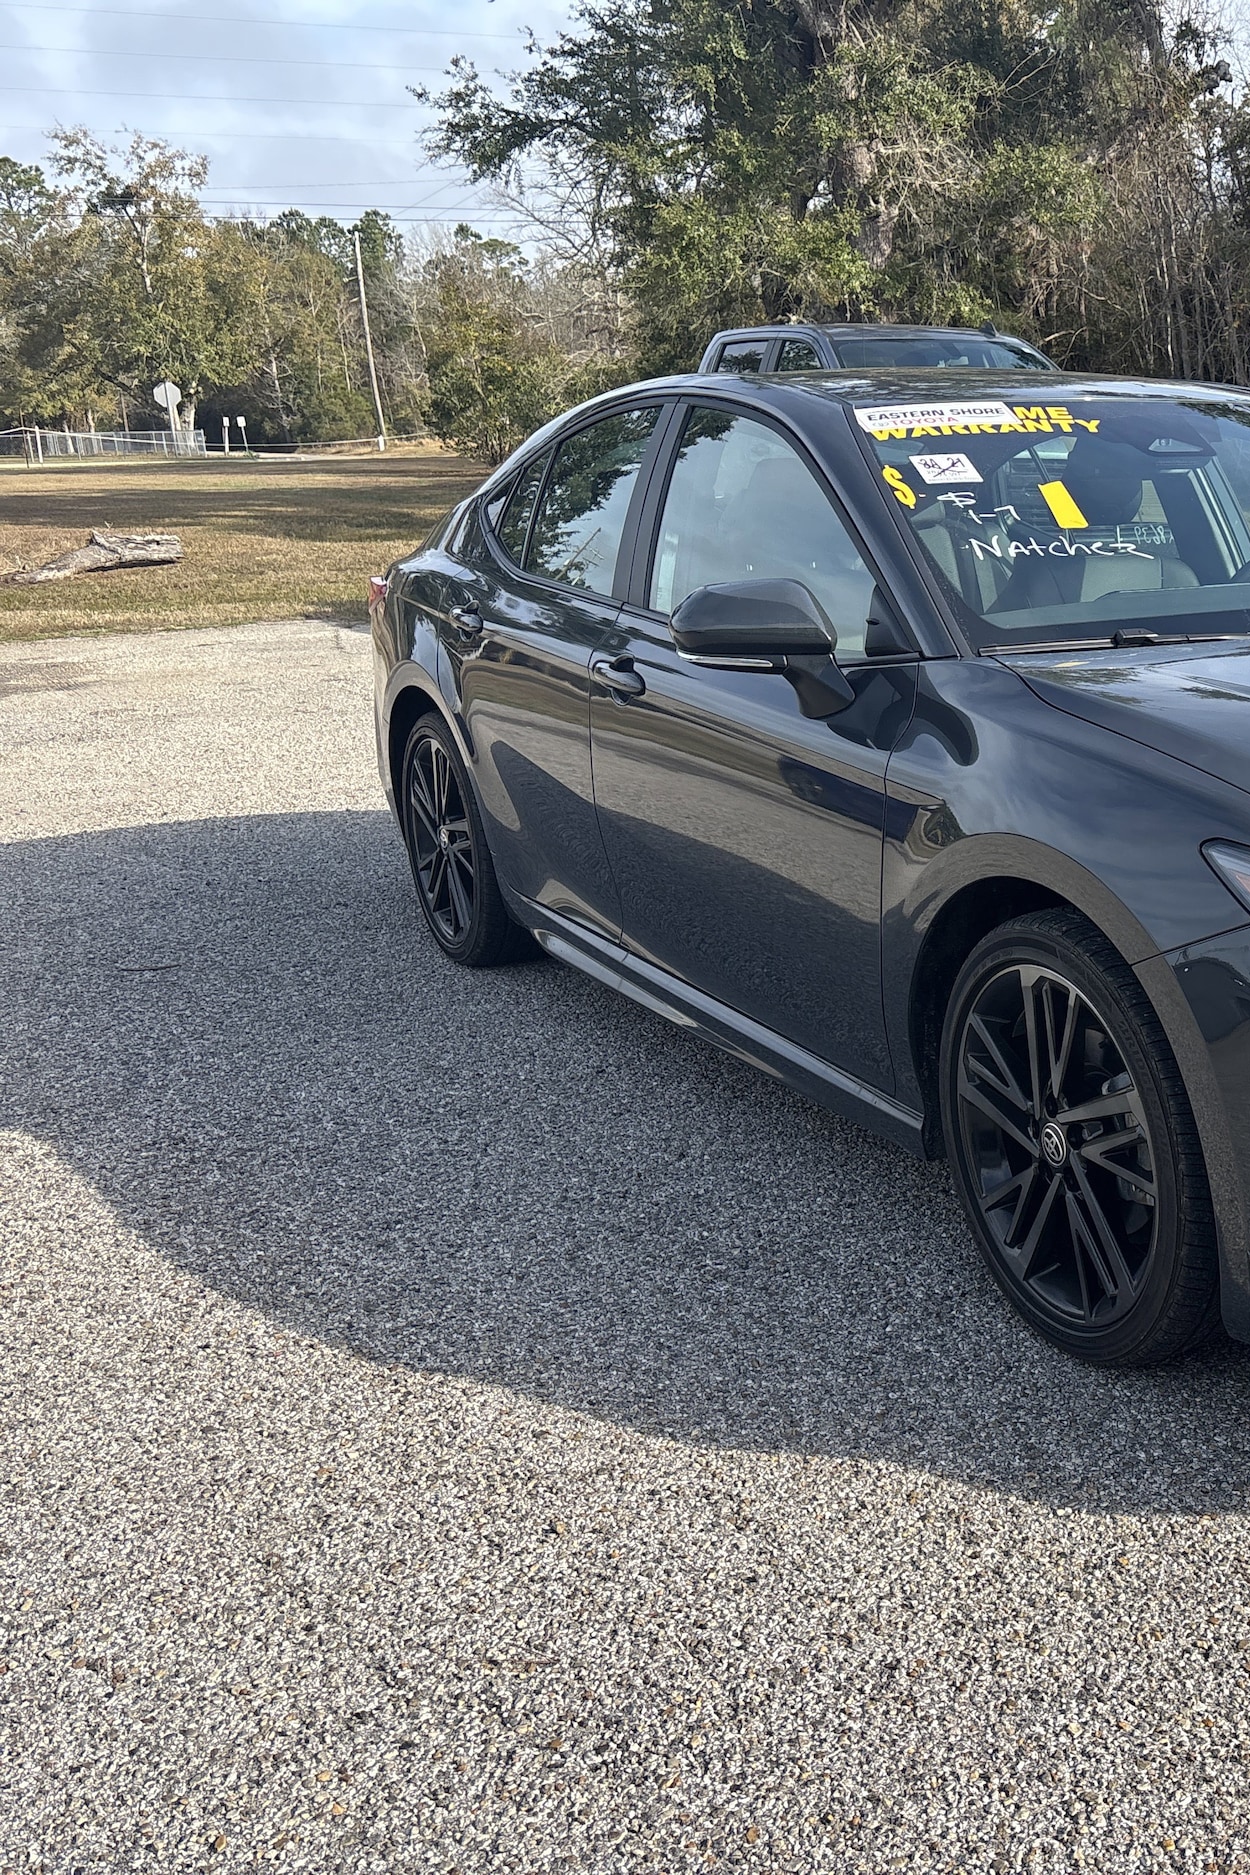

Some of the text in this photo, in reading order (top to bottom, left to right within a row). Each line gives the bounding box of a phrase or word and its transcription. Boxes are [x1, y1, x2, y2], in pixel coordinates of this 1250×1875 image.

[867, 407, 1006, 421] EASTERN SHORE
[891, 416, 959, 426] TOYOTA
[869, 419, 1101, 441] WARRANTY
[882, 464, 917, 510] $
